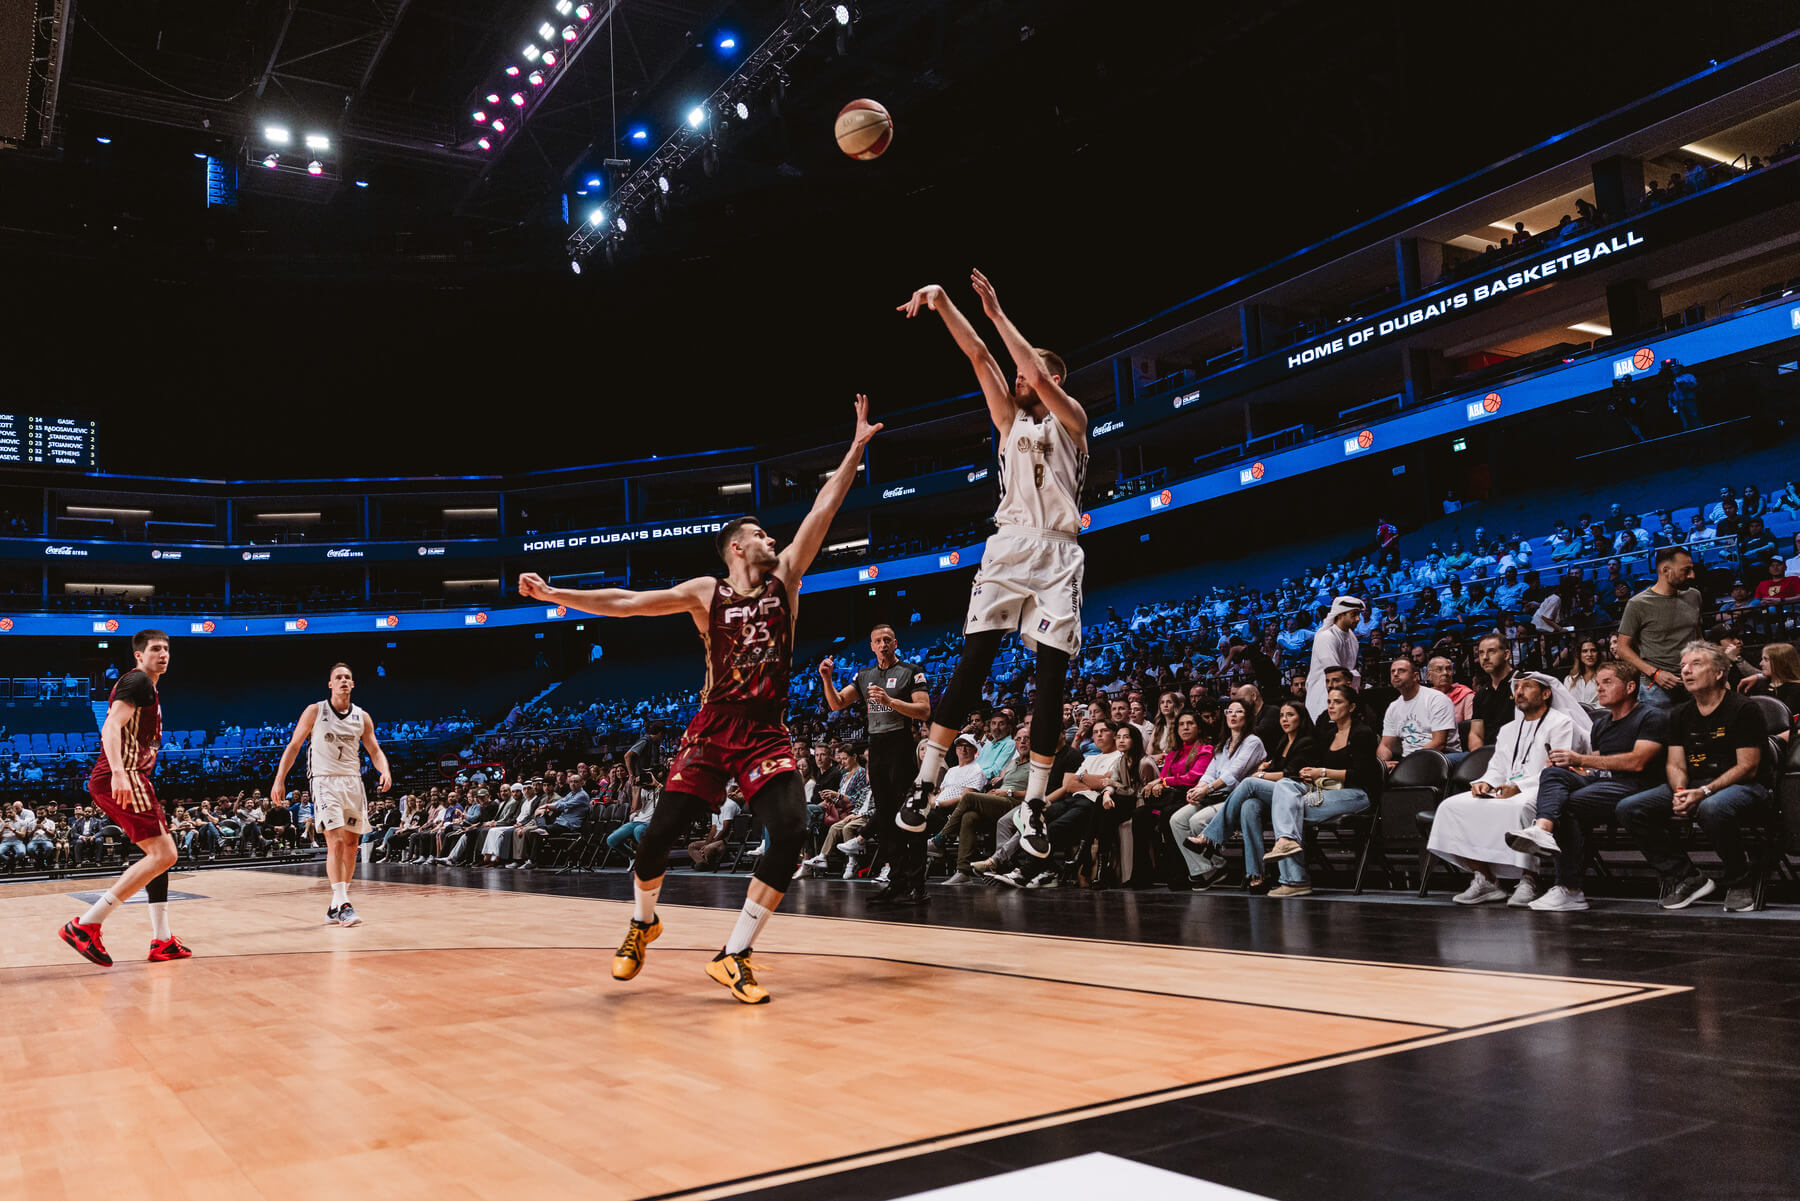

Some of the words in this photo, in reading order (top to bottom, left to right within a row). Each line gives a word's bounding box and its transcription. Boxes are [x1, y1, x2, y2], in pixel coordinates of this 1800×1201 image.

[1288, 339, 1344, 369] HOME
[1348, 327, 1375, 347] OF
[1379, 293, 1469, 337] DUBAI'S
[1474, 231, 1645, 302] BASKETBALL
[1615, 359, 1634, 377] ABA
[1468, 402, 1485, 417] ABA
[524, 538, 565, 552] HOME
[568, 536, 587, 547] OF
[590, 529, 649, 545] DUBAI'S
[652, 522, 729, 538] BASKETB
[45, 545, 72, 556] Coca-Cola
[724, 595, 781, 625] FMP
[741, 621, 770, 646] 23
